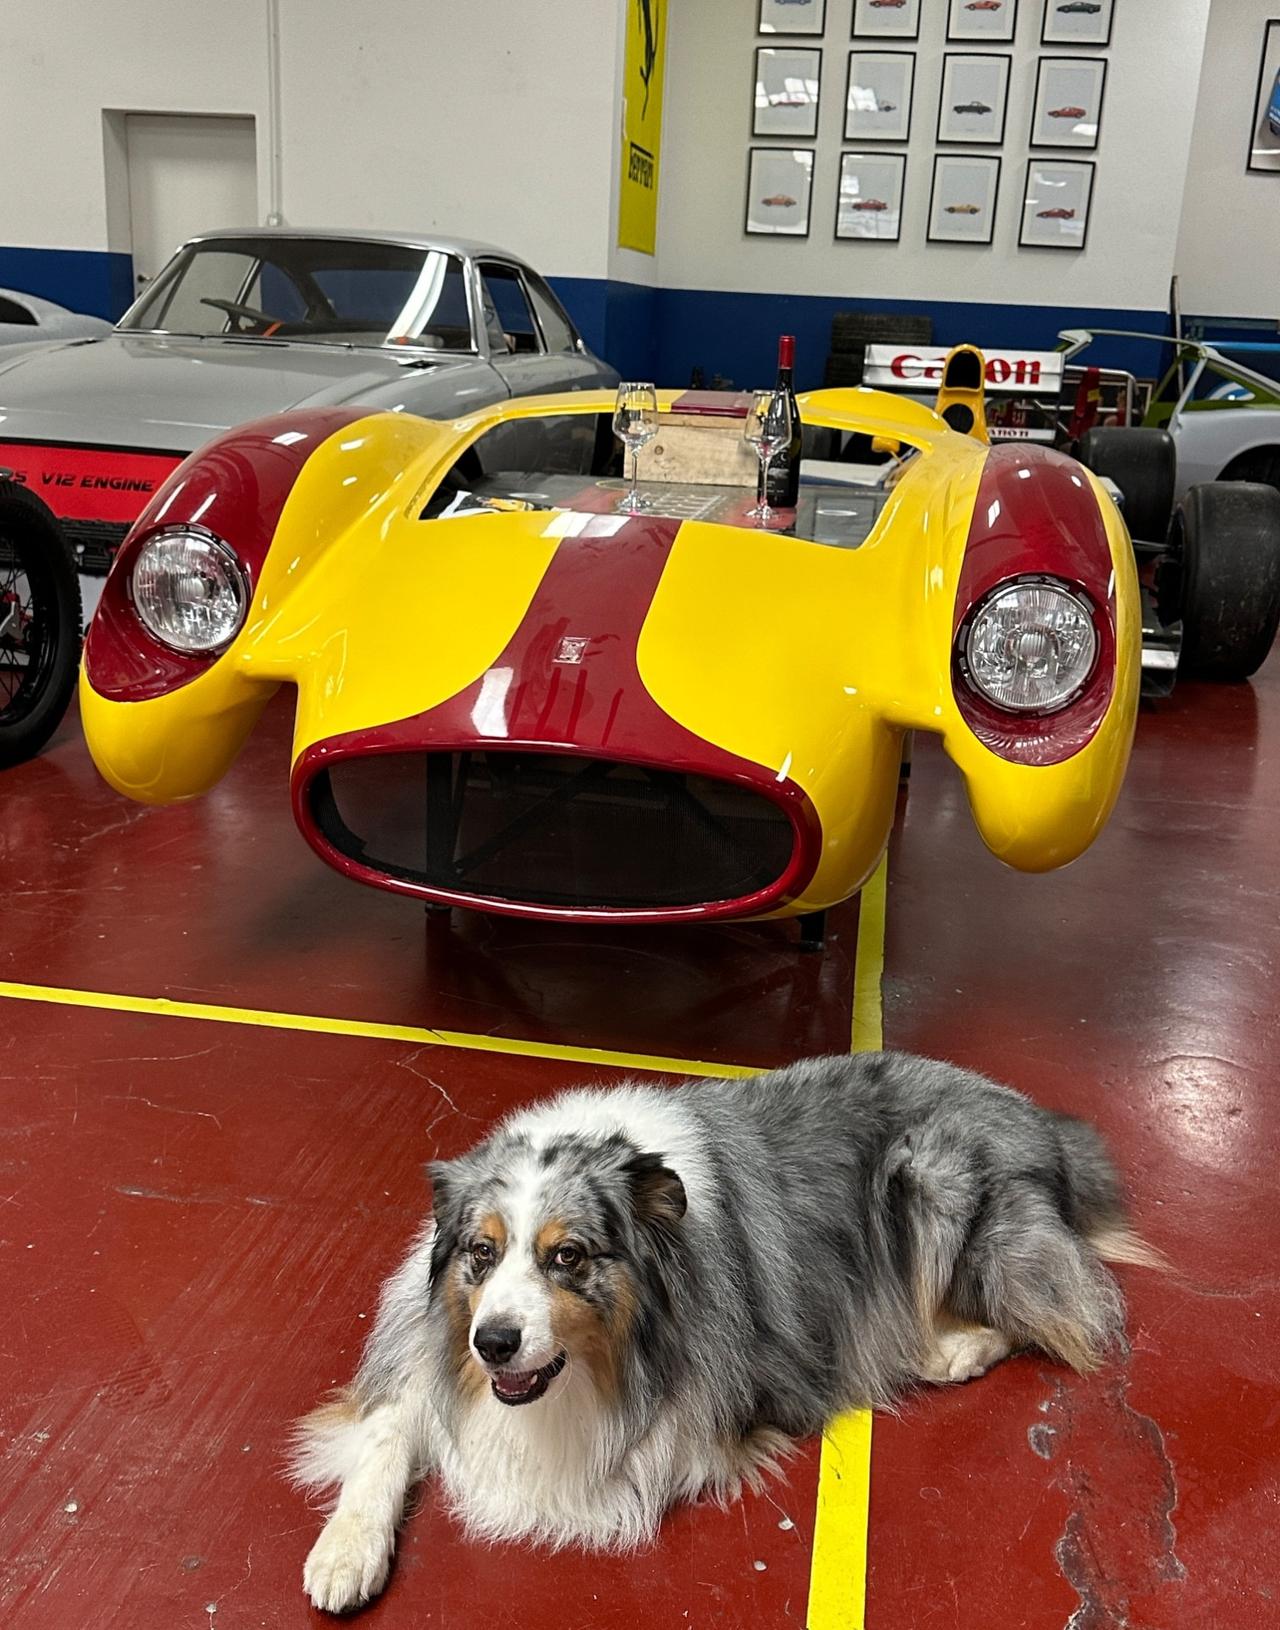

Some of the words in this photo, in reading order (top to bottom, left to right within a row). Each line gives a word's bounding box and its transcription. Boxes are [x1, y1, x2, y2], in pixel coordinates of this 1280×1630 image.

[629, 141, 654, 189] Ferrari
[890, 354, 1041, 384] Caon
[41, 472, 76, 487] V12
[80, 475, 156, 492] ENGINE
